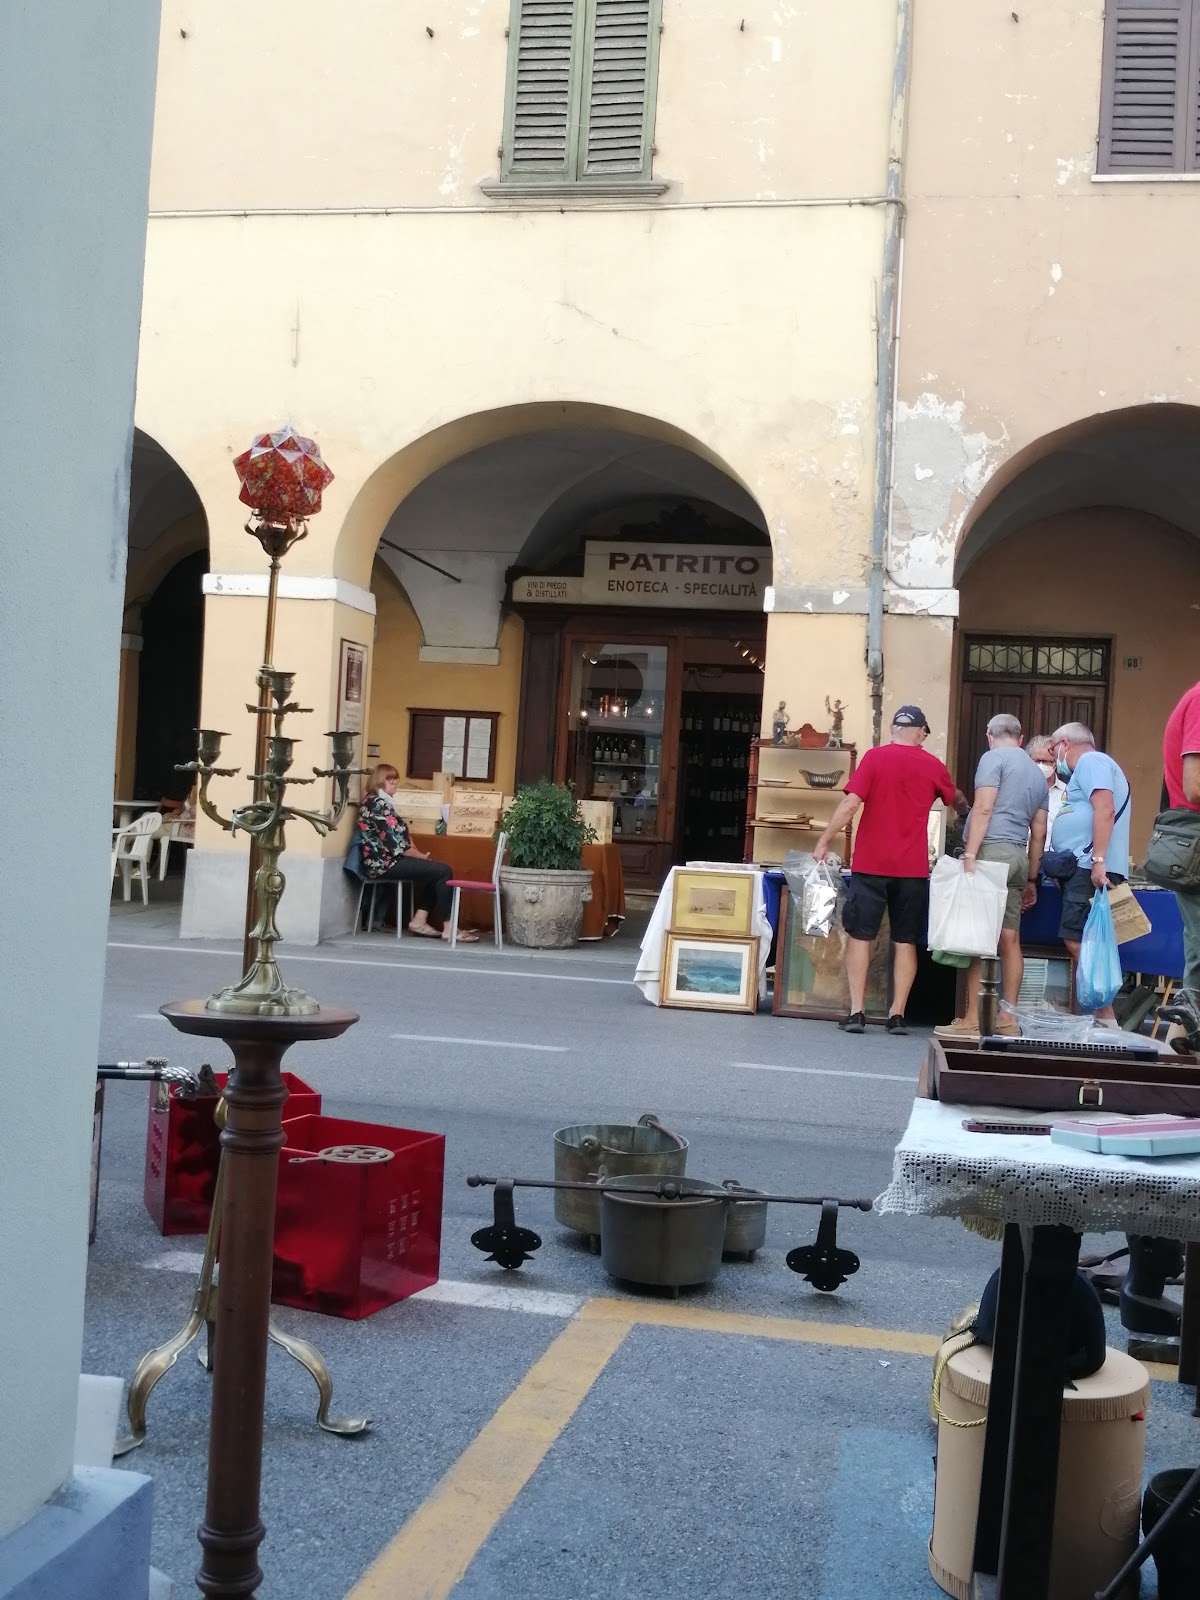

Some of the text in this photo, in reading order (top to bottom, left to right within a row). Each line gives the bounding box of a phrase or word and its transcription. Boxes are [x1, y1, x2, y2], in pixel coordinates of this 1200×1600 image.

[608, 552, 760, 575] PATRITO
[527, 581, 538, 589] VINI
[547, 582, 567, 590] PREGIO
[607, 579, 757, 597] ENOTECA SPECIALITÀ
[526, 589, 567, 598] & DISTILLATI
